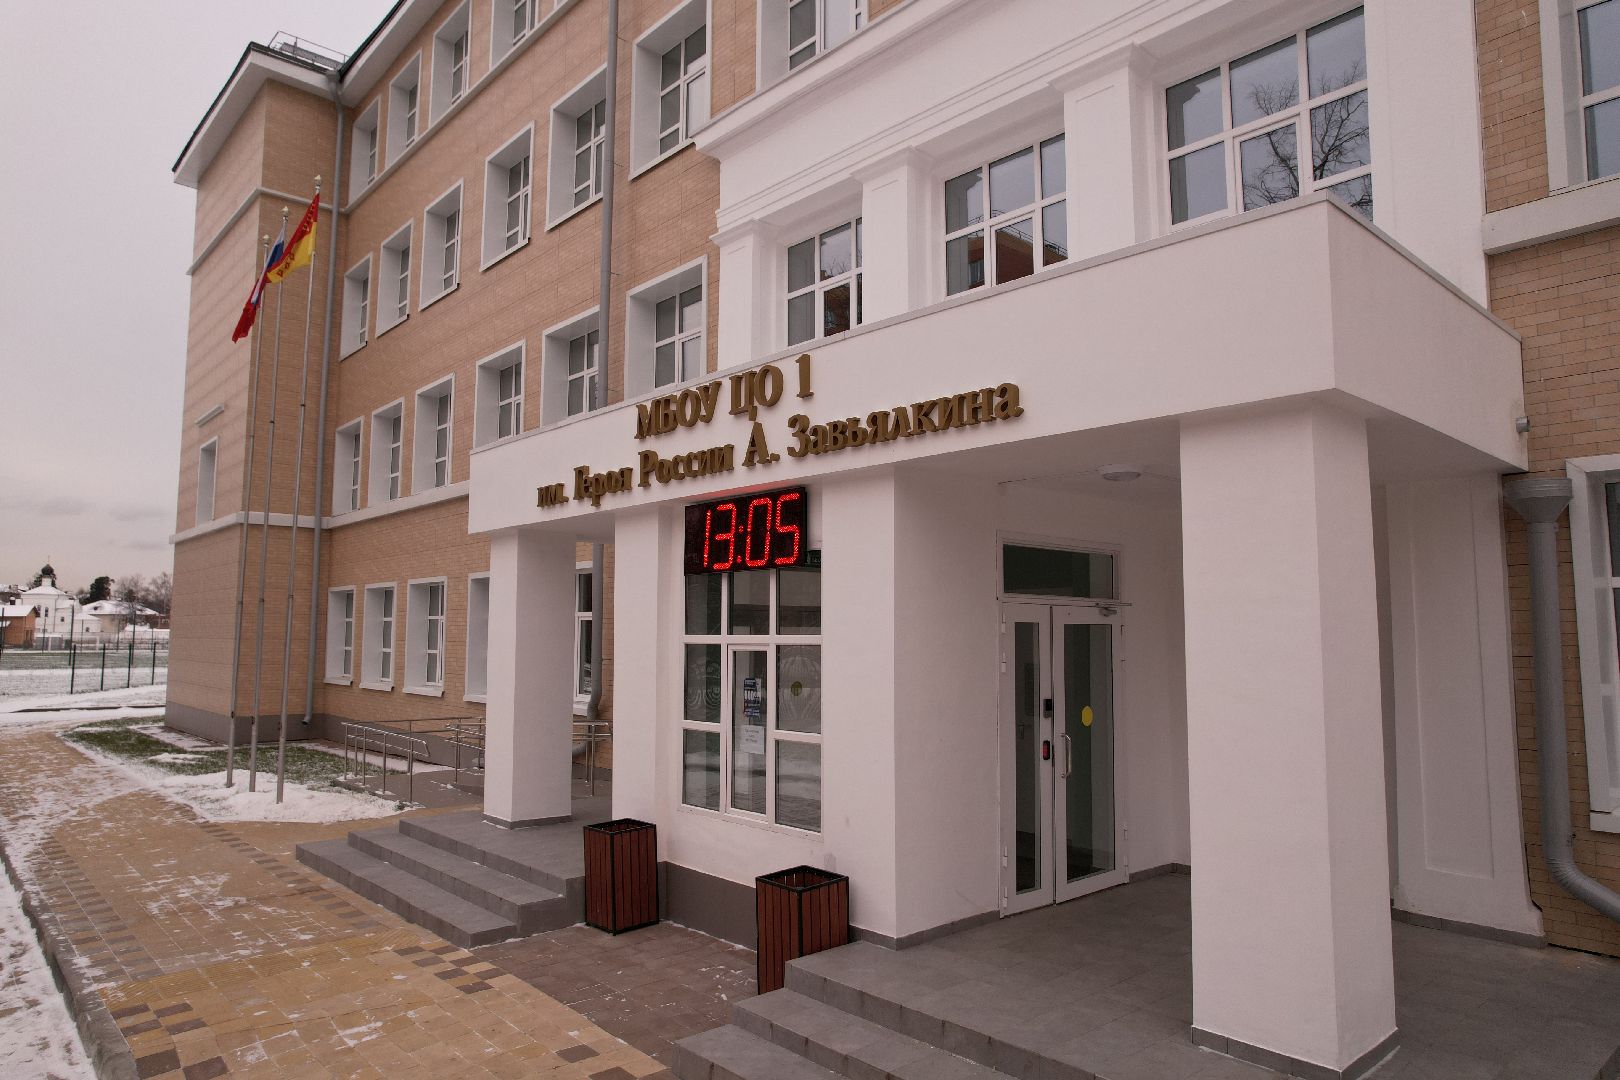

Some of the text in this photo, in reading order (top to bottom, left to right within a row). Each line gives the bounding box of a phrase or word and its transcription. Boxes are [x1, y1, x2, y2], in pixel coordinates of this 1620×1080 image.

[633, 353, 815, 440] МБОУ ЦО 1
[537, 382, 1024, 508] им. Героя России А. Завьялкина
[703, 492, 800, 571] 13:05
